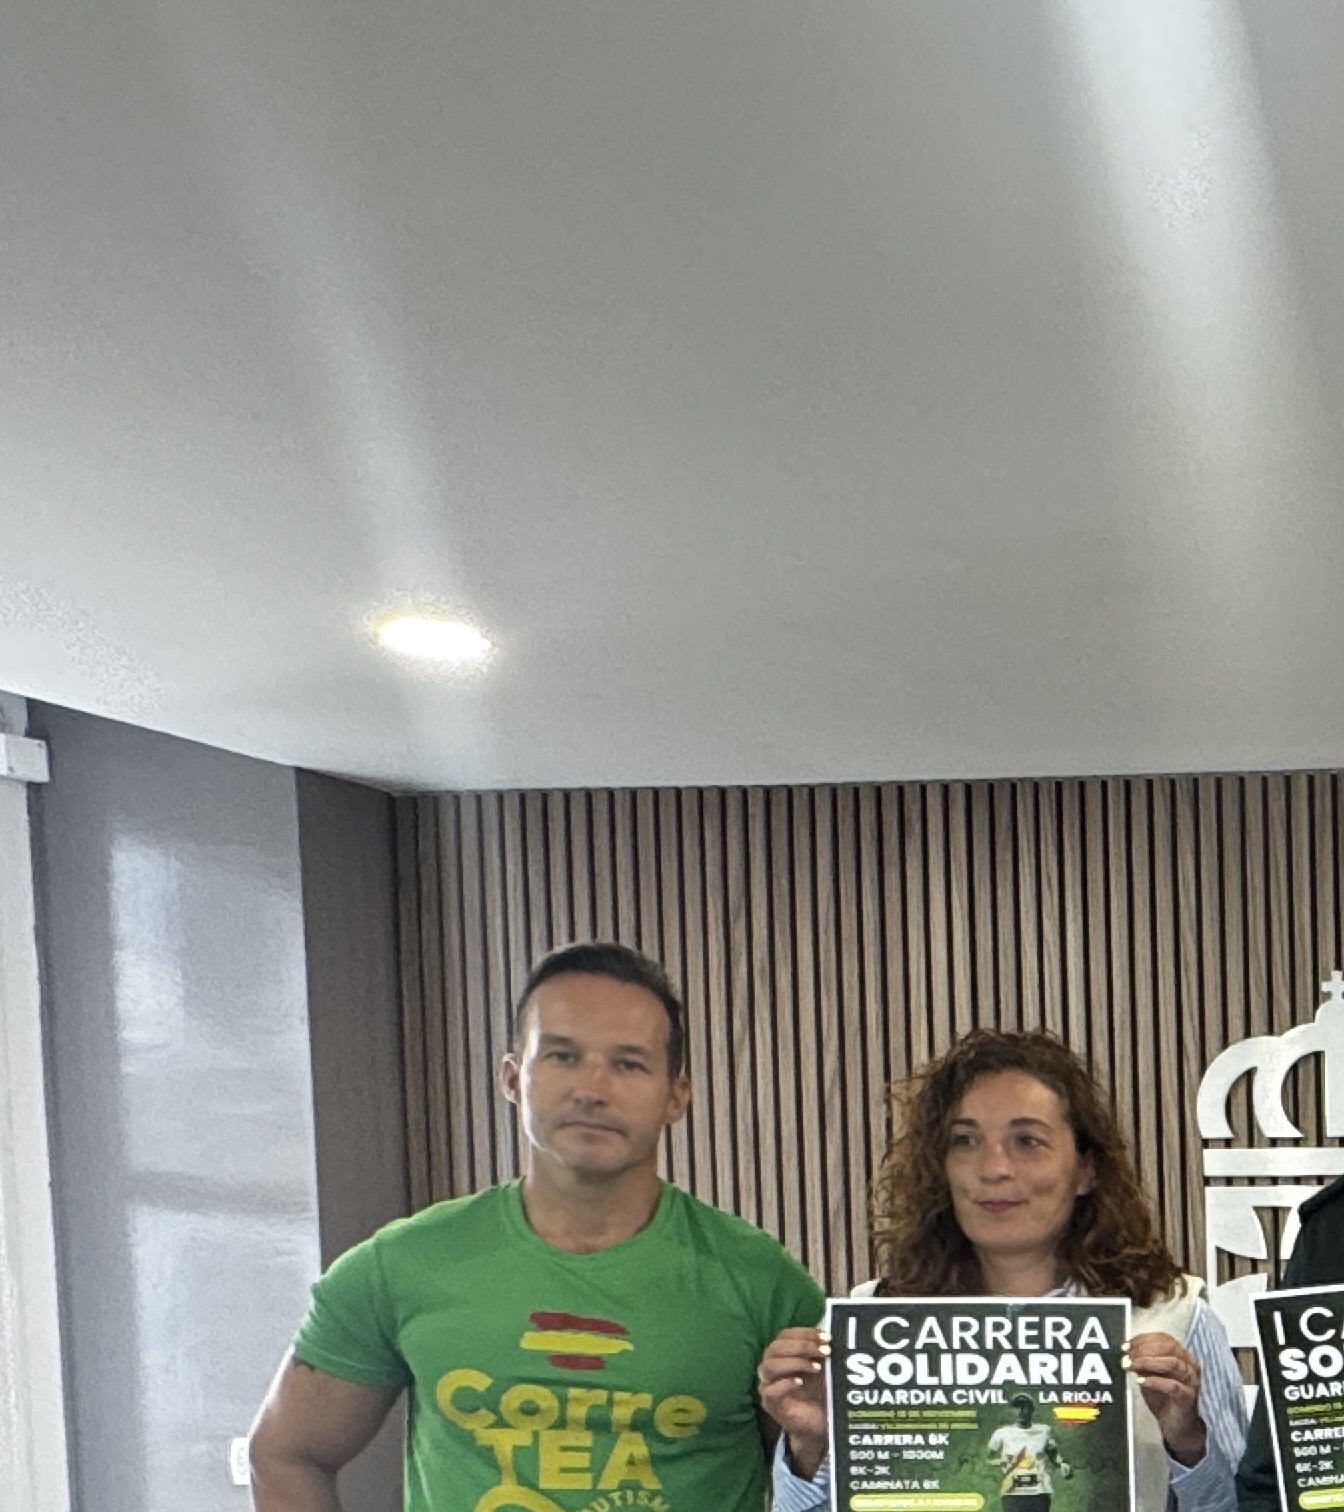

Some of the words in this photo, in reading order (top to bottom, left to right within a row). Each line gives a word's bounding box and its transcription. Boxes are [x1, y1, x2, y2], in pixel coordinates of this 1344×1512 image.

[847, 1316, 857, 1350] I
[873, 1315, 1110, 1350] CARRERA
[1273, 1310, 1286, 1345] I
[846, 1352, 1113, 1386] SOLIDARIA
[436, 1368, 708, 1439] Corre
[848, 1388, 947, 1406] GUARDIA
[951, 1388, 1008, 1405] CIVIL
[1038, 1390, 1060, 1404] LA
[1062, 1390, 1113, 1405] RIOJA
[848, 1434, 925, 1446] CARRERA
[474, 1428, 662, 1490] TEA
